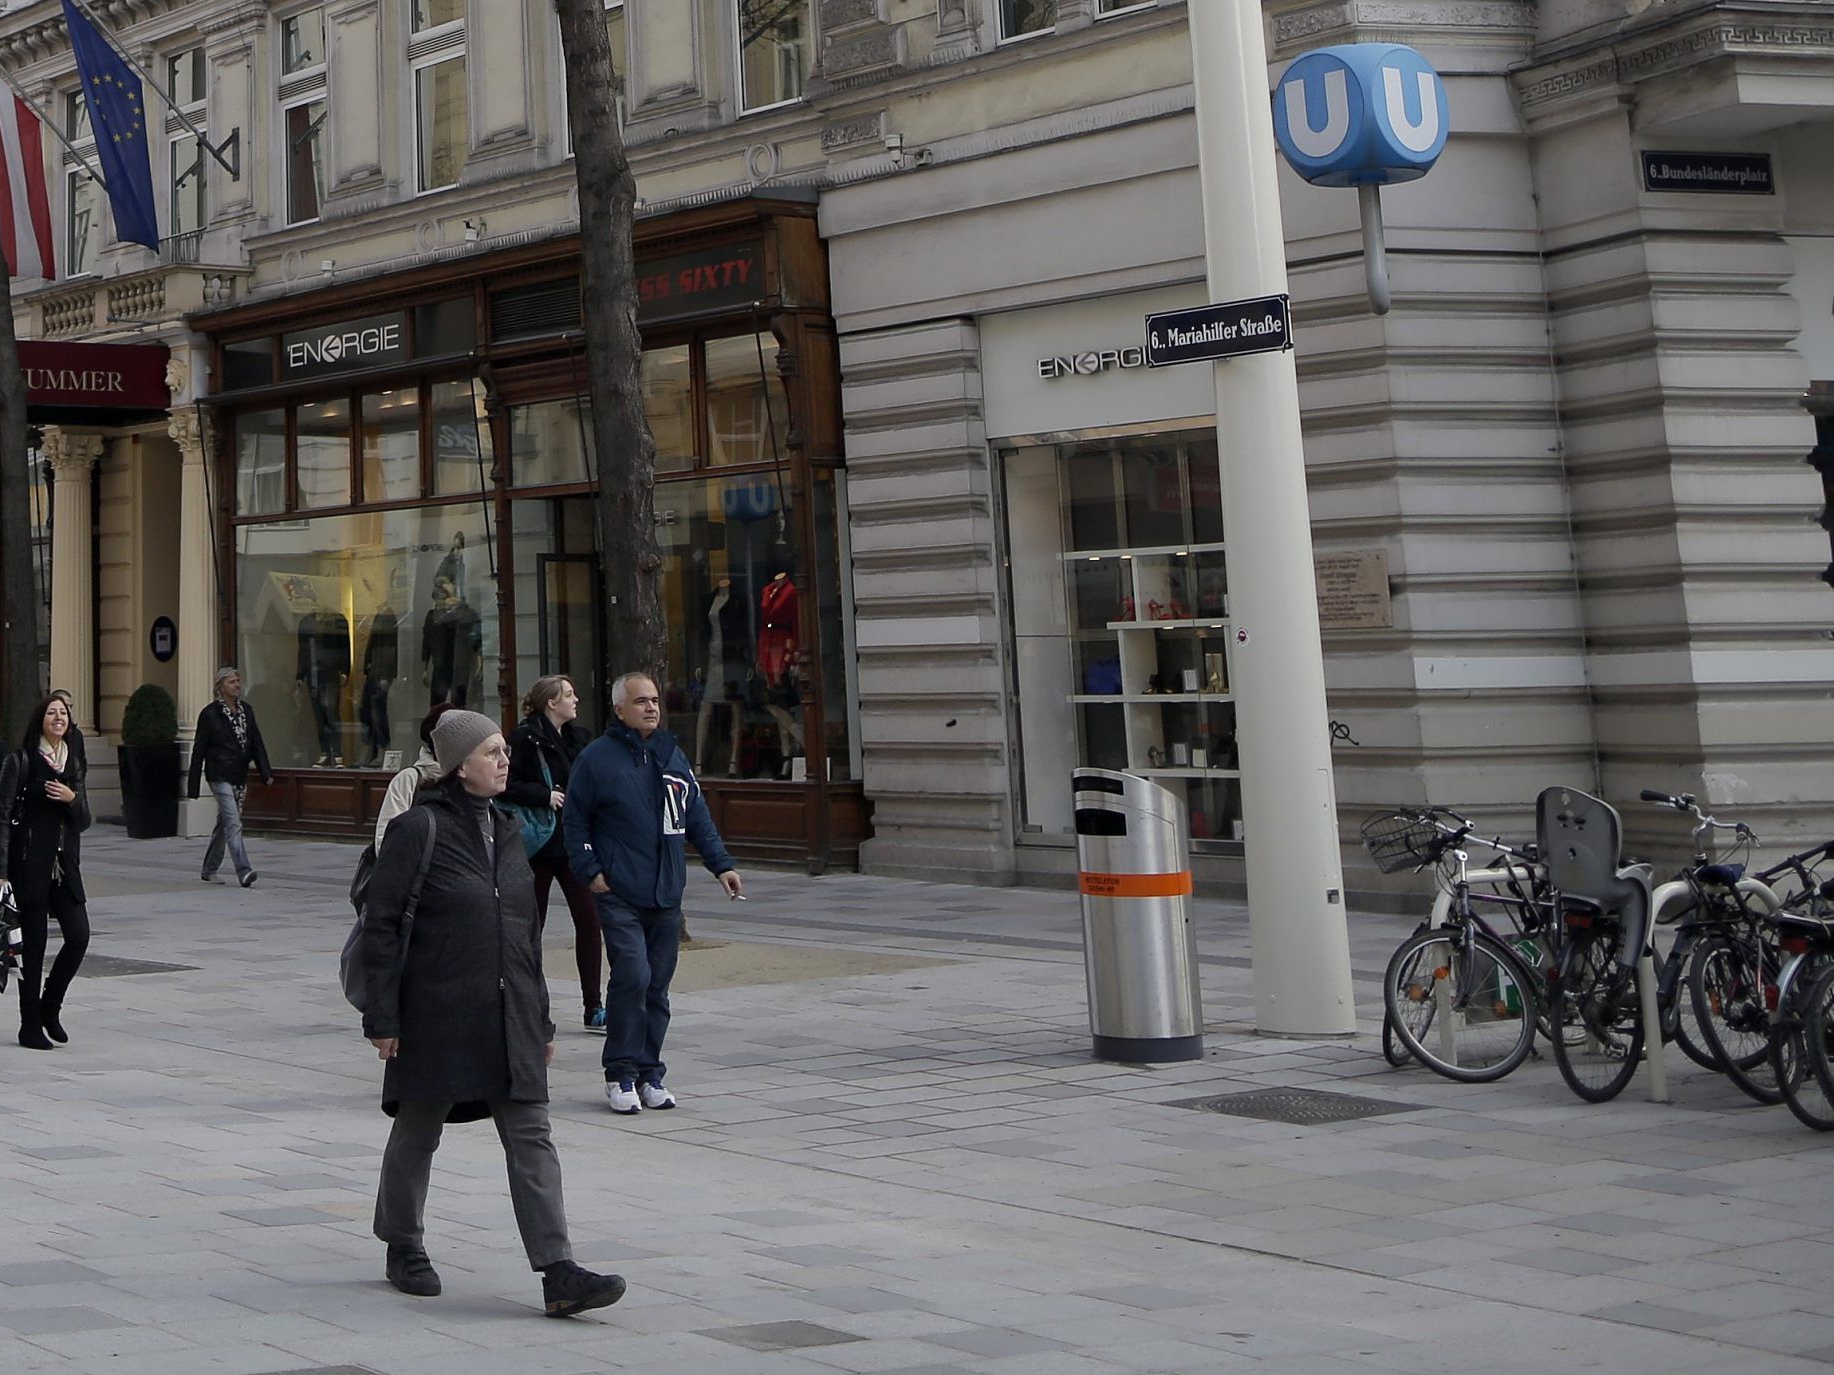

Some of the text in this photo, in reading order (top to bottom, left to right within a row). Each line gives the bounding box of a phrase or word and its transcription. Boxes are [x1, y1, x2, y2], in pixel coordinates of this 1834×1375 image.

[1284, 69, 1349, 157] U
[1382, 67, 1439, 152] U
[677, 258, 752, 295] SIXTY
[1167, 323, 1237, 348] Mariahilfer
[1240, 314, 1282, 337] Straße
[1037, 345, 1147, 379] ENERGI
[21, 370, 124, 393] UMMER
